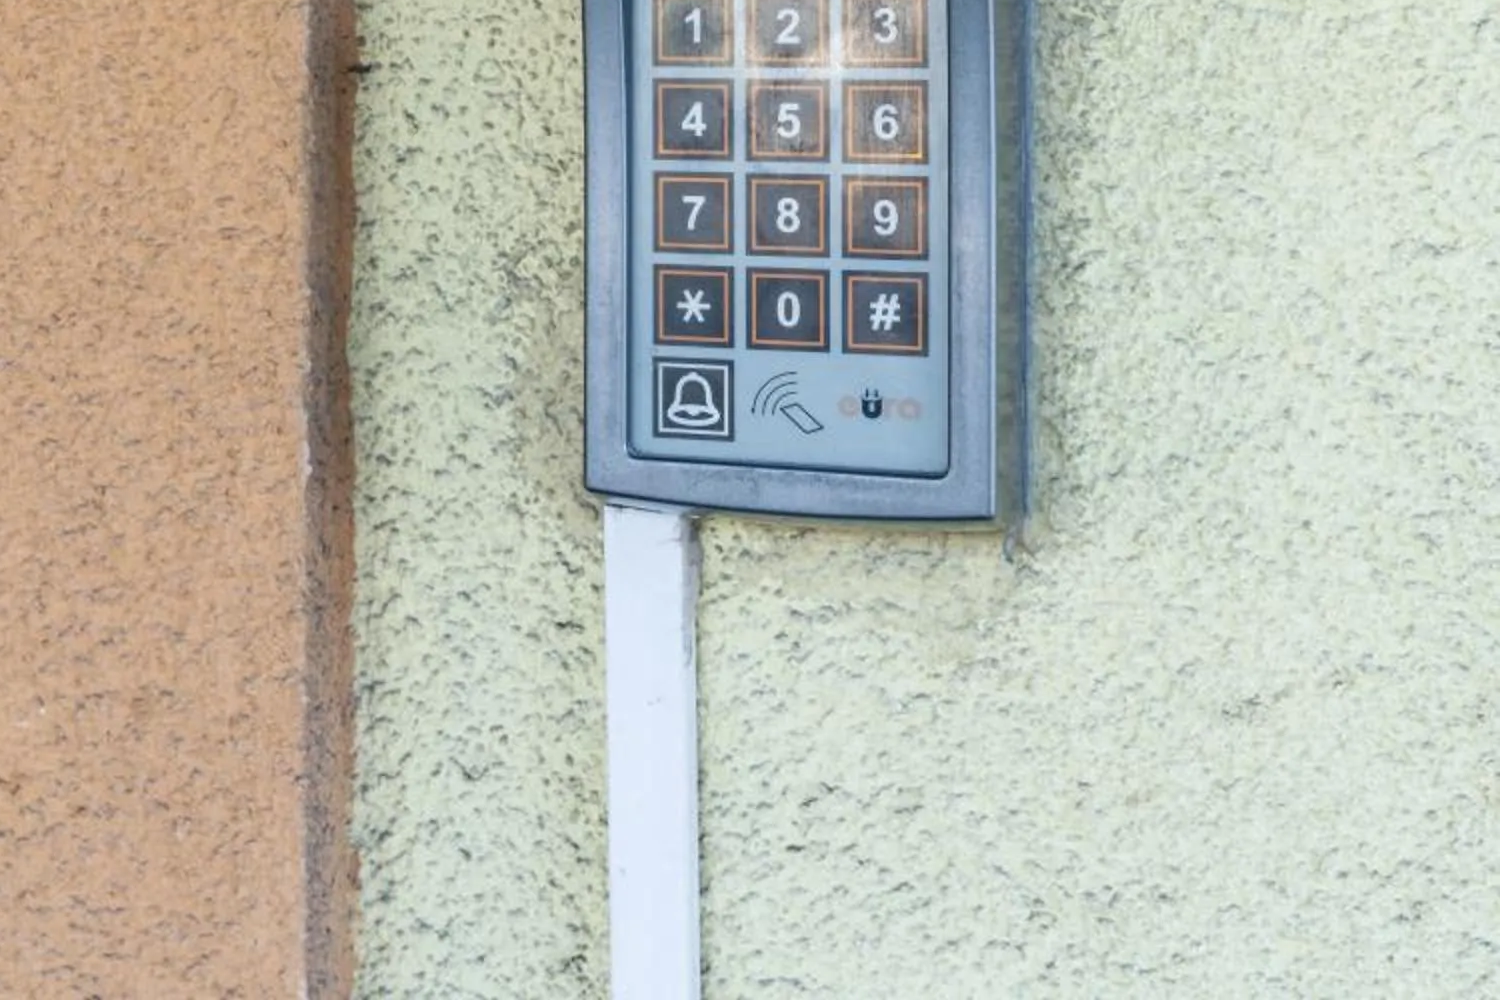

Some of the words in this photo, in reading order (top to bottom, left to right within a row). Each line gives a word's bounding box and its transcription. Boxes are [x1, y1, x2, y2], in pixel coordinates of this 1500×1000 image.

[685, 7, 701, 43] 1
[776, 7, 801, 44] 2
[873, 7, 899, 44] 3
[681, 101, 707, 137] 4
[776, 102, 801, 139] 5
[873, 103, 900, 141] 6
[682, 195, 706, 231] 7
[775, 197, 801, 233] 8
[873, 199, 899, 236] 9
[776, 291, 801, 328] 0
[869, 293, 901, 331] #
